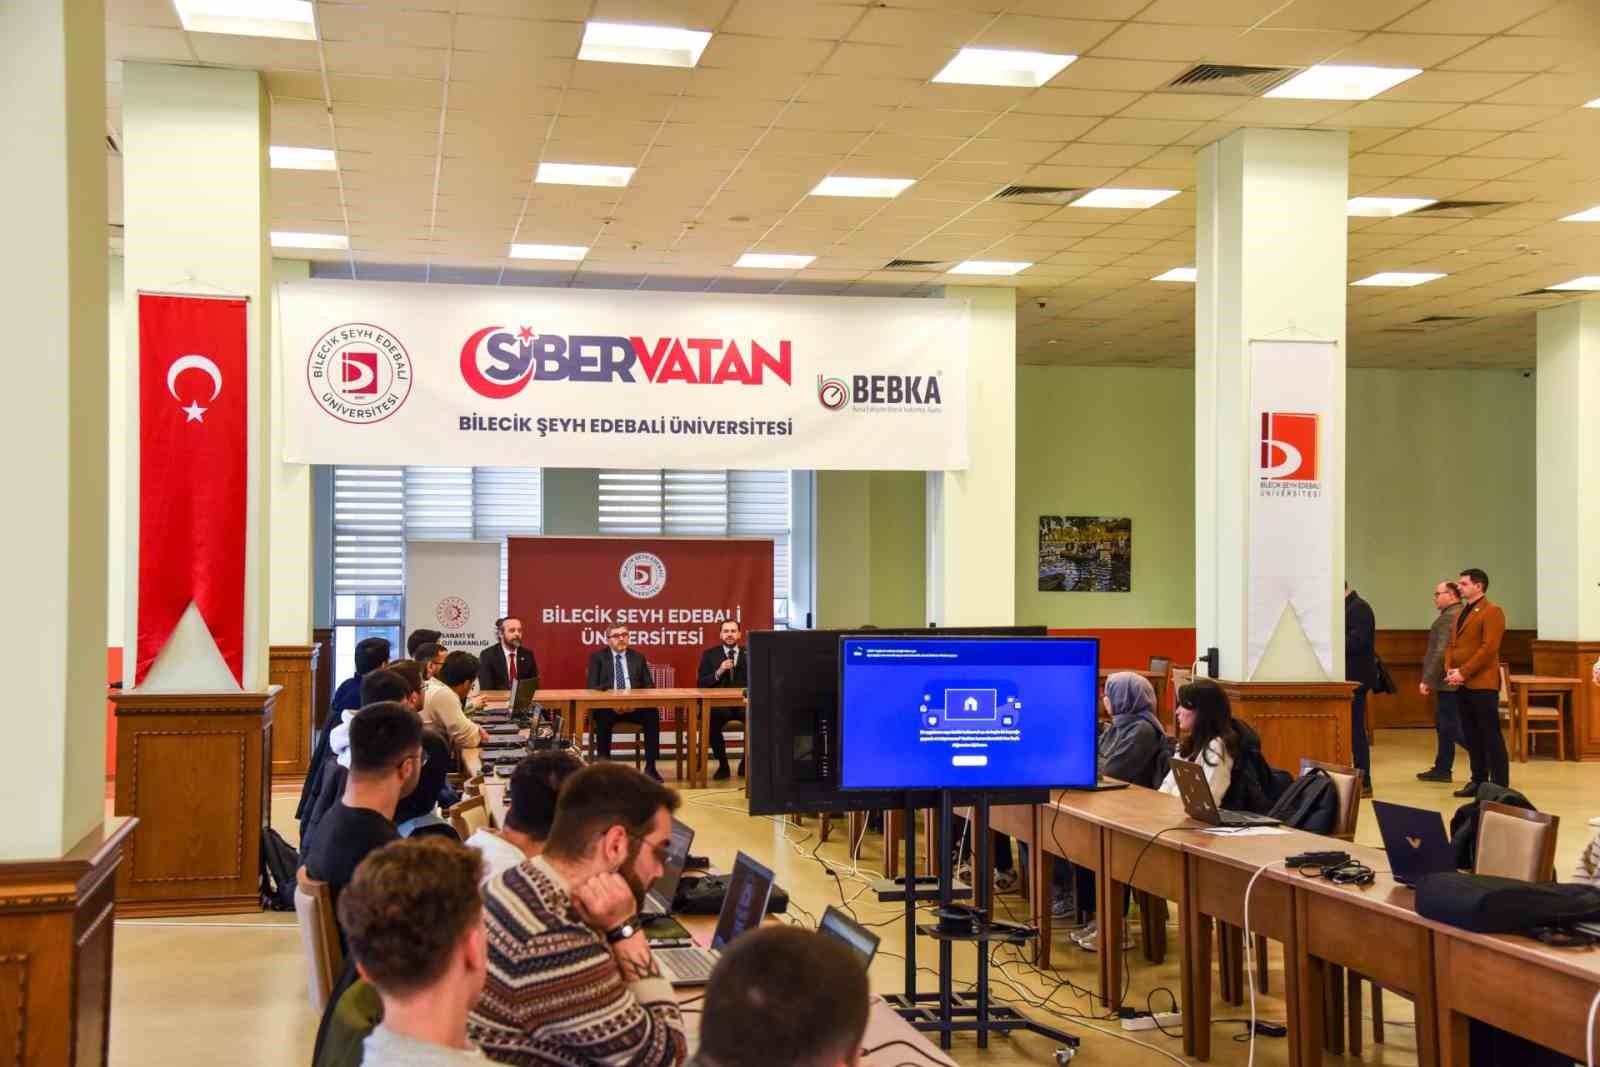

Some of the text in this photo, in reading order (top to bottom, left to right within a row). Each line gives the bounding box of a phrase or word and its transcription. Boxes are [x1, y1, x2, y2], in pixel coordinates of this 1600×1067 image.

[853, 375, 941, 404] BEBKA
[459, 412, 793, 437] BİLECİK ŞEYH EDEBALİ ÜNİVERSİTESİ
[542, 605, 612, 623] BİLECİK
[582, 627, 704, 645] ÜNERSİTESİ
